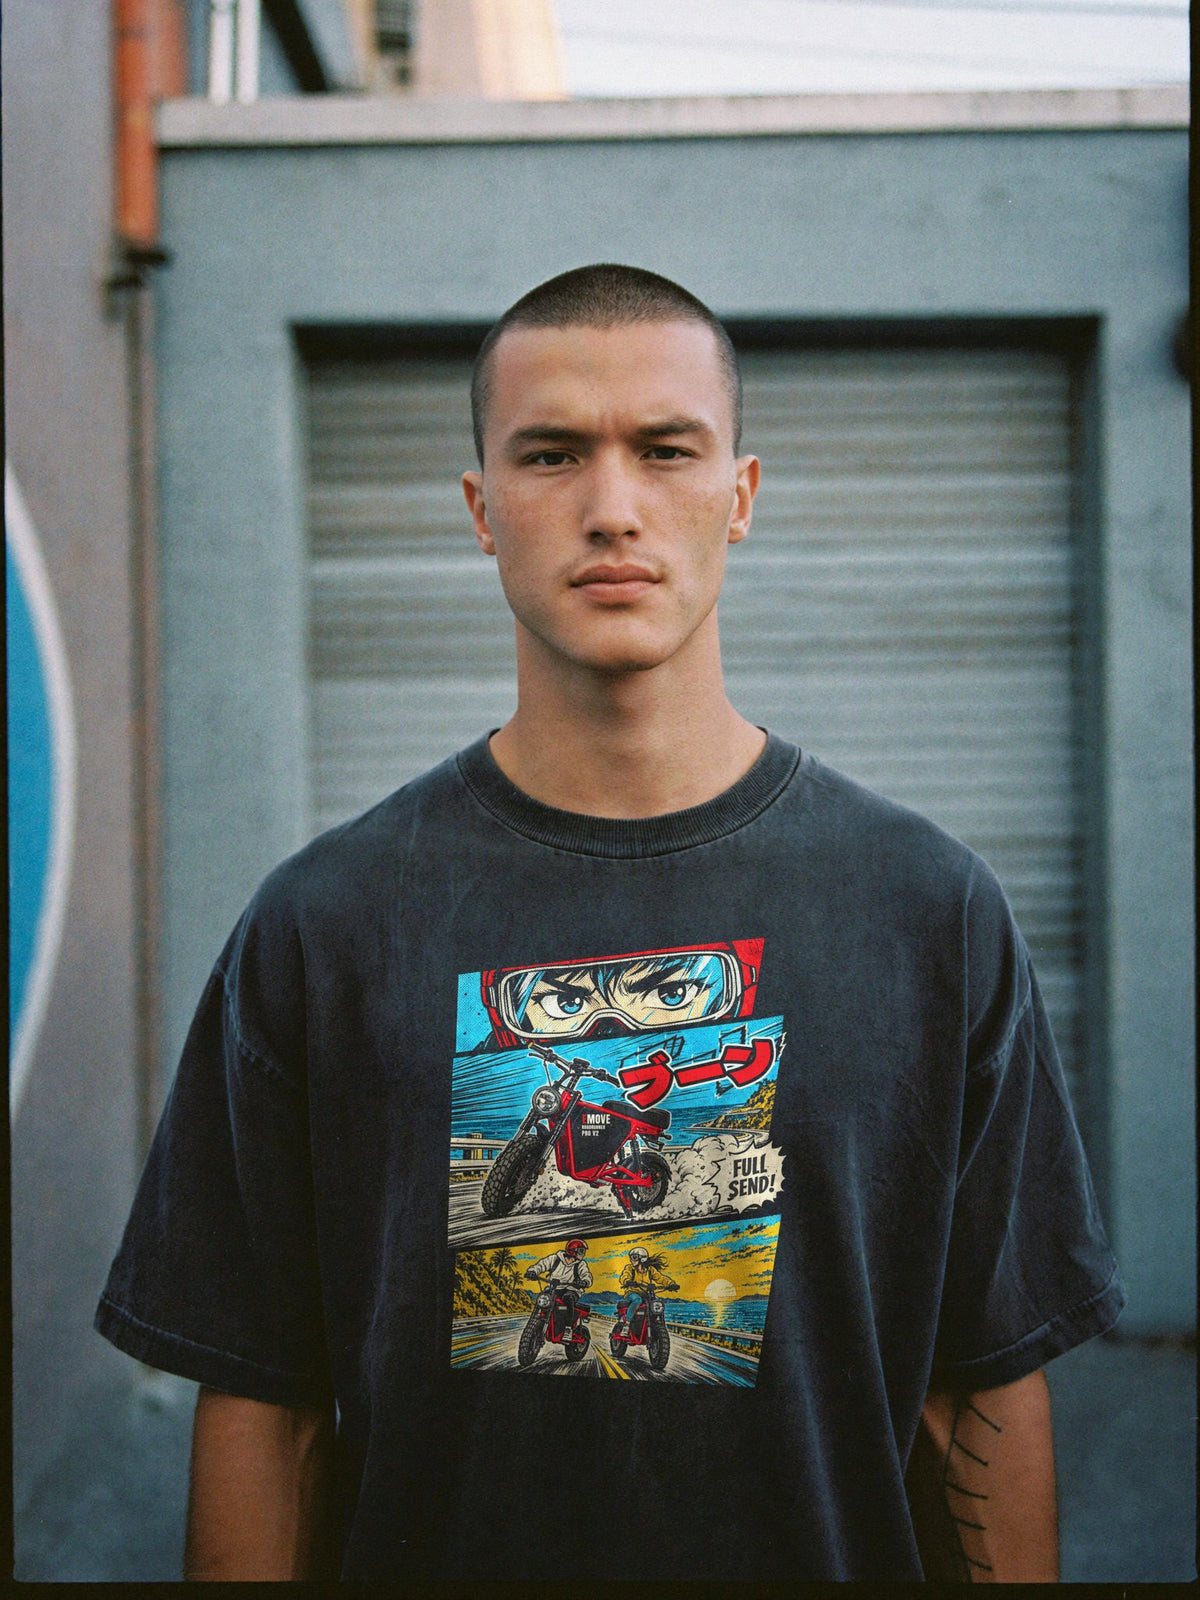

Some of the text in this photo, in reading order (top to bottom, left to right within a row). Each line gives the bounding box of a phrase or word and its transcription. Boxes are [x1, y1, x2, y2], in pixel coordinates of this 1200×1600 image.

[618, 1038, 775, 1111] ブーン
[582, 1114, 611, 1125] EMOVE
[734, 1154, 767, 1178] FULL
[728, 1175, 776, 1201] SEND!
